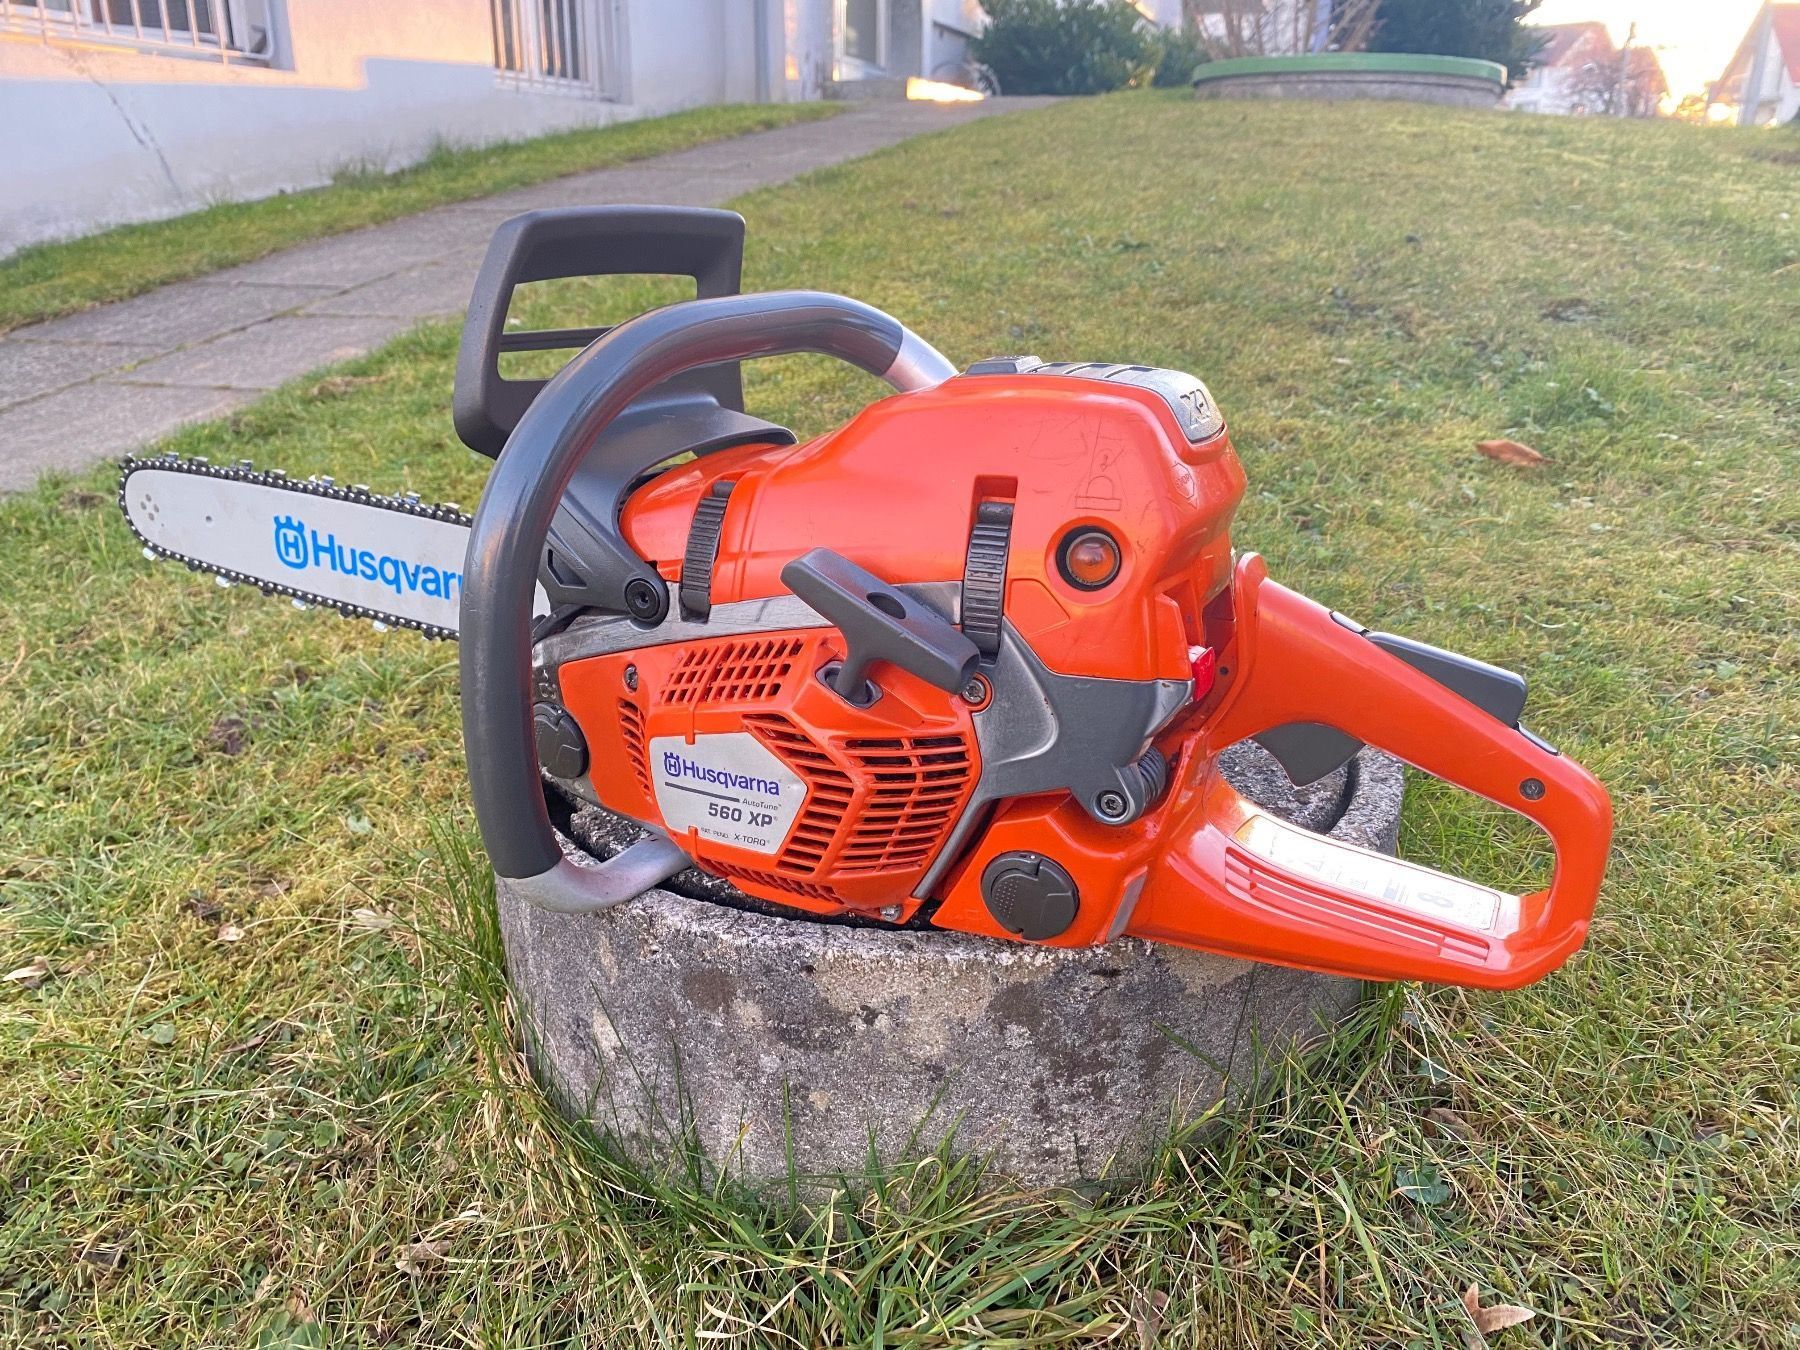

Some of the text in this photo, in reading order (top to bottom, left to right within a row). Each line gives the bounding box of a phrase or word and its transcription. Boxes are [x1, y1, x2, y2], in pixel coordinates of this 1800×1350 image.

[311, 529, 463, 600] Husqvar
[682, 759, 780, 796] Husqvarna
[708, 802, 773, 828] 560 XP
[734, 833, 767, 847] X-TORQ
